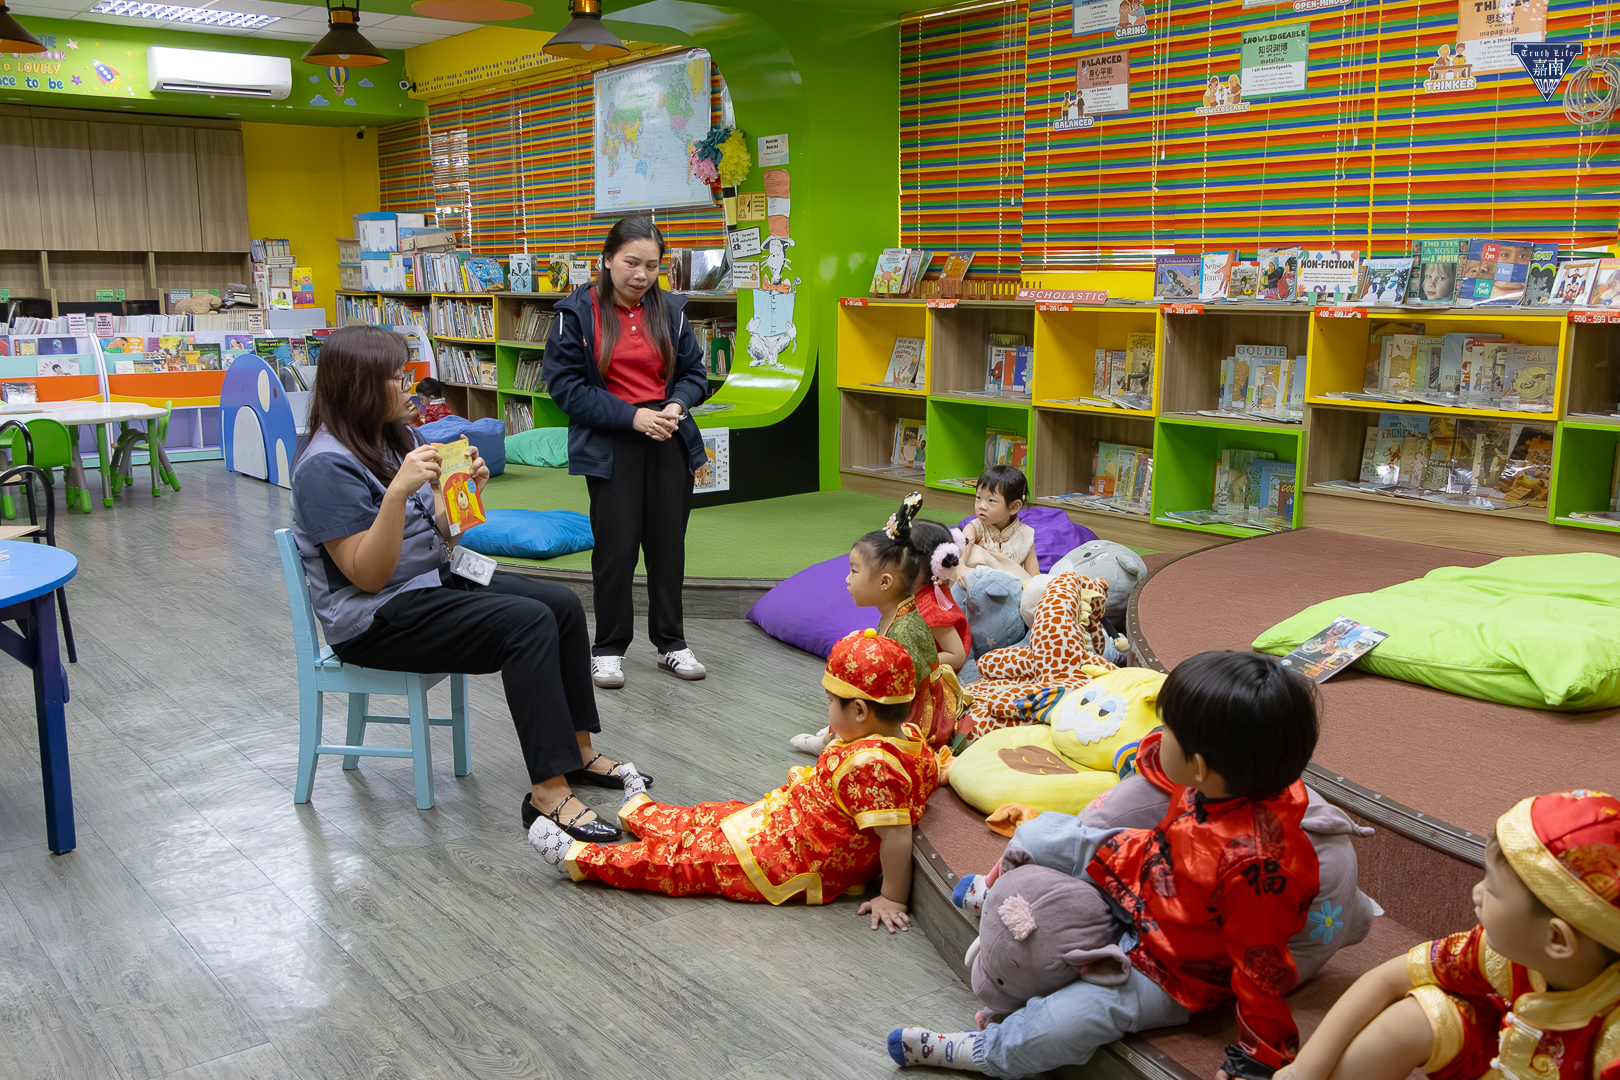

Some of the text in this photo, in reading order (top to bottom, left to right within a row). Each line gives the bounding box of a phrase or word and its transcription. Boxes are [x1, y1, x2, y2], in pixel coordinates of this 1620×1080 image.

[1116, 25, 1146, 37] CARING
[1480, 27, 1519, 37] mapag-isip
[1243, 30, 1306, 45] KNOWLEDGEABLE
[40, 50, 66, 61] BOOK
[1521, 49, 1549, 58] Truth
[1082, 55, 1122, 68] BALANCED
[3, 61, 61, 75] a LOVELY
[25, 76, 39, 88] to
[48, 77, 64, 90] be
[1426, 79, 1475, 91] THINKER
[1195, 104, 1250, 115] KNOWLEDGEABLE
[1054, 118, 1093, 129] BALANCED
[1485, 252, 1495, 260] Eyes
[1301, 260, 1355, 269] NON-FICTION
[1204, 274, 1222, 282] Touch
[1029, 290, 1104, 301] SCHOLASTIC
[1476, 287, 1490, 295] Mouth
[1319, 310, 1329, 318] 400
[1574, 315, 1587, 323] 500
[1593, 315, 1606, 323] 599
[1237, 346, 1285, 356] GOLDIE
[1241, 857, 1287, 896] 福
